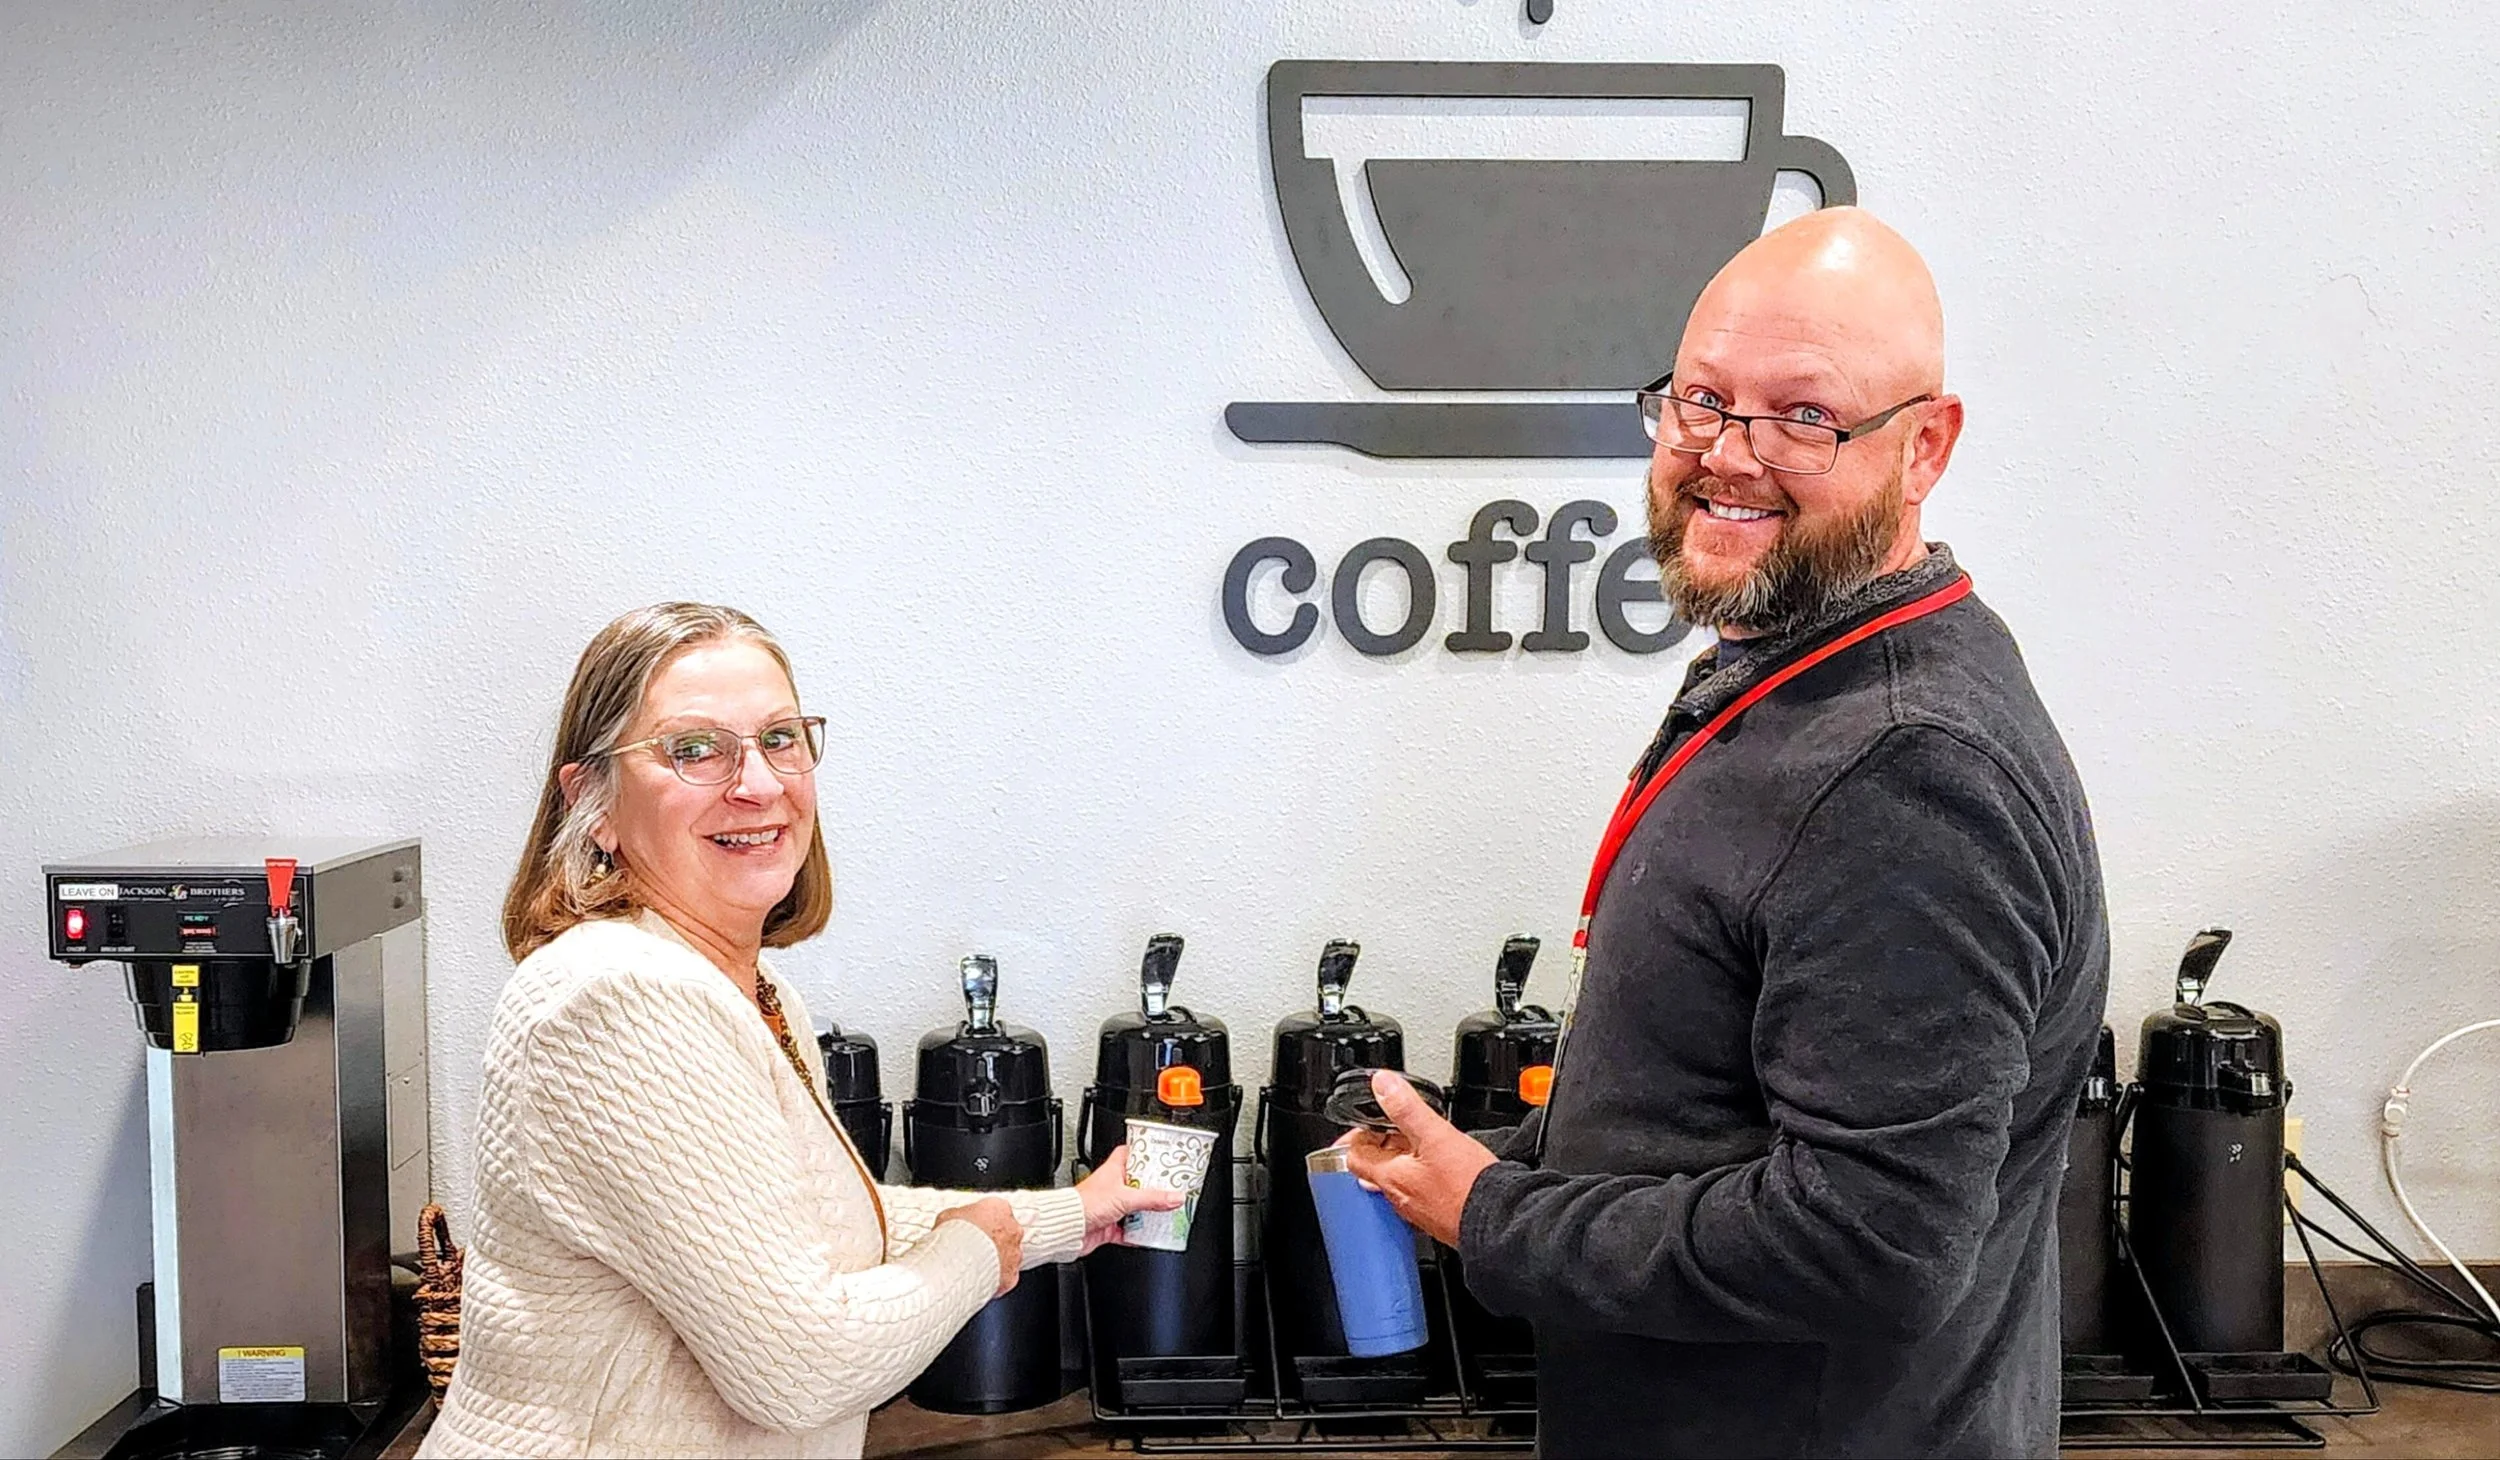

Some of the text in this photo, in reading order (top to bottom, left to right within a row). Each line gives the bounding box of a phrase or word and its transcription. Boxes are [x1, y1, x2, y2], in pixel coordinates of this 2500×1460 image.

[1222, 499, 1696, 655] coffe
[61, 887, 115, 897] LEAVE ON
[119, 886, 246, 896] JACKSON BROTHERS
[242, 1349, 286, 1357] WARNING
